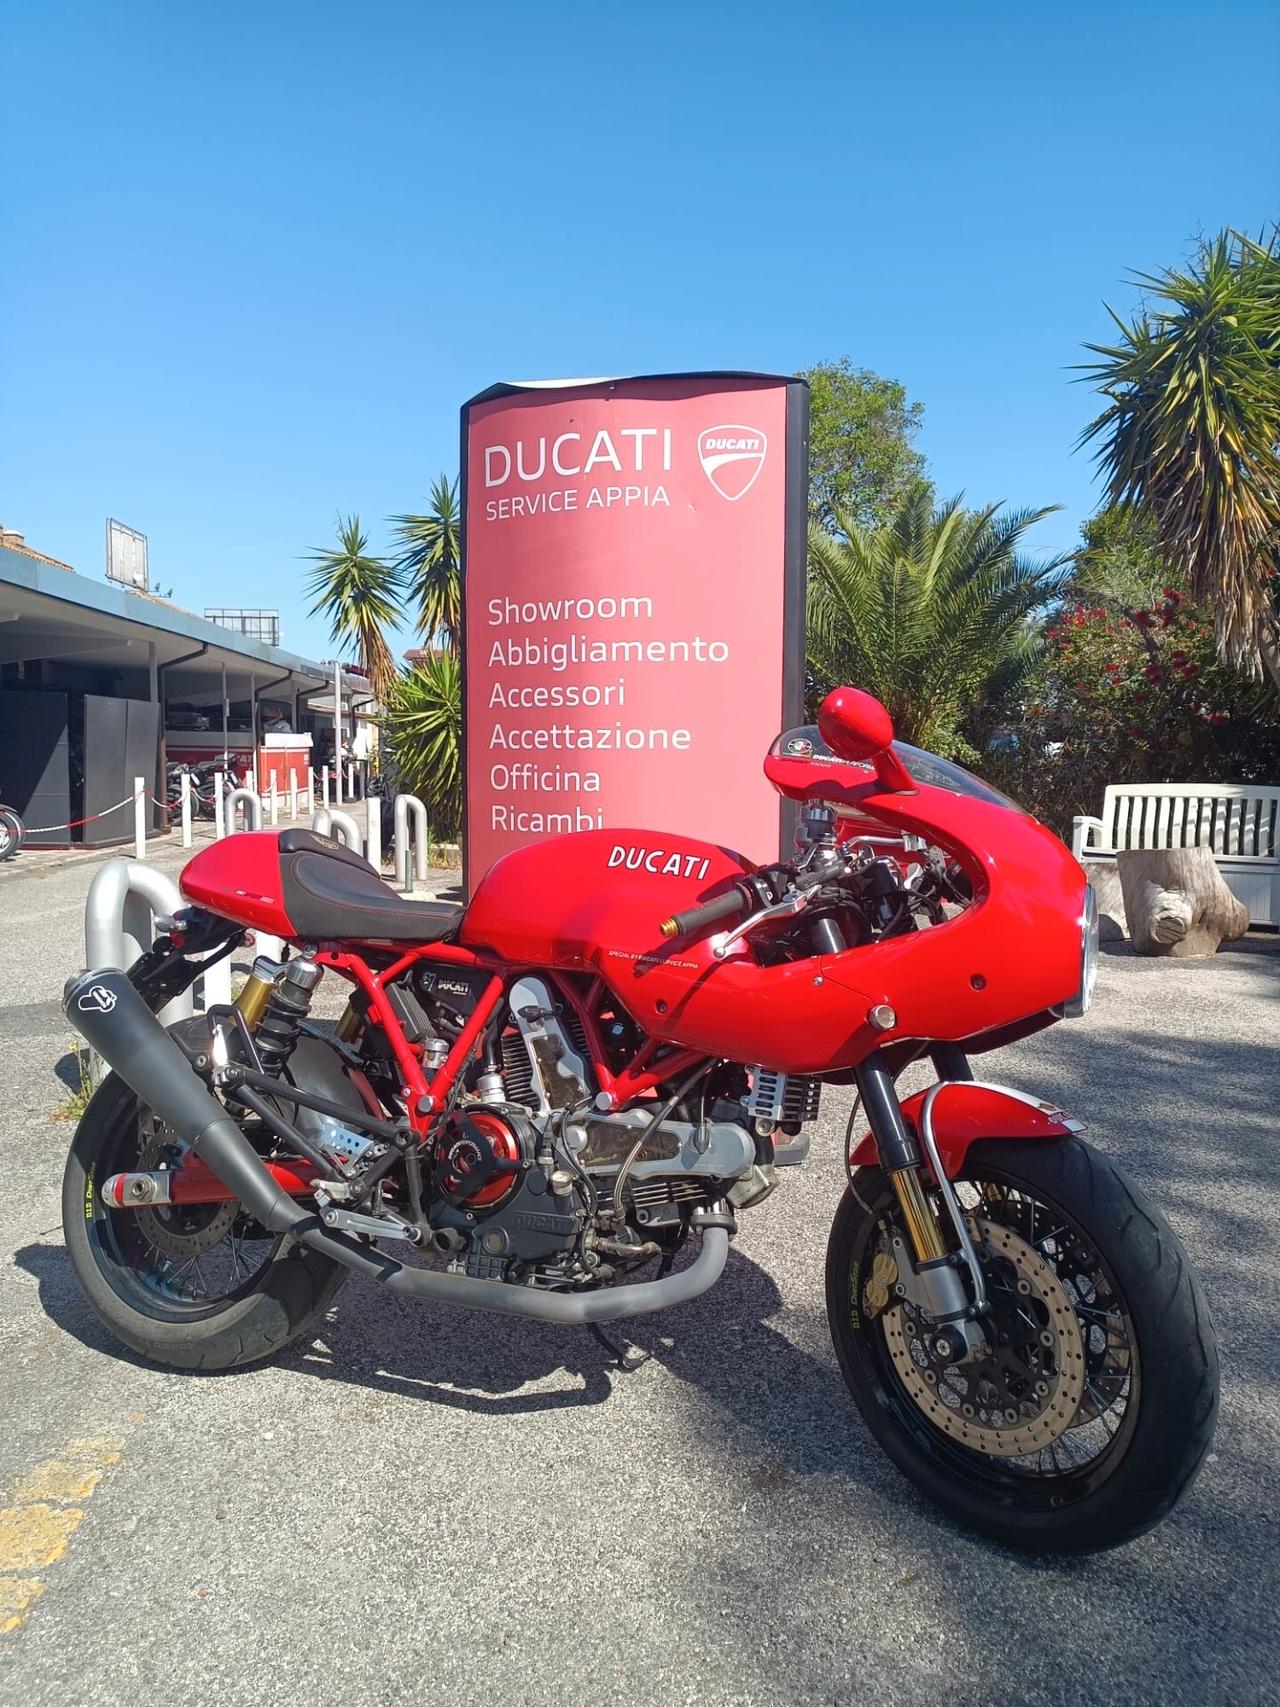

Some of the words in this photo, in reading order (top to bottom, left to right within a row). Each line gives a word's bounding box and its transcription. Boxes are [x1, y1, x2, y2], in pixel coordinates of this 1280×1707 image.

[484, 428, 673, 488] DUCATI
[705, 438, 760, 450] DUCATI
[486, 489, 579, 521] SERVICE
[586, 485, 670, 510] APPIA
[487, 595, 653, 626] Showroom
[487, 635, 730, 671] Abbigliamento
[488, 679, 625, 709] Accessori
[489, 722, 692, 750] Accettazione
[490, 764, 601, 793] Officina
[491, 805, 604, 833] Ricambi
[607, 845, 712, 880] DUCATI
[608, 950, 630, 959] SPECIAL
[437, 979, 470, 992] DUCATI
